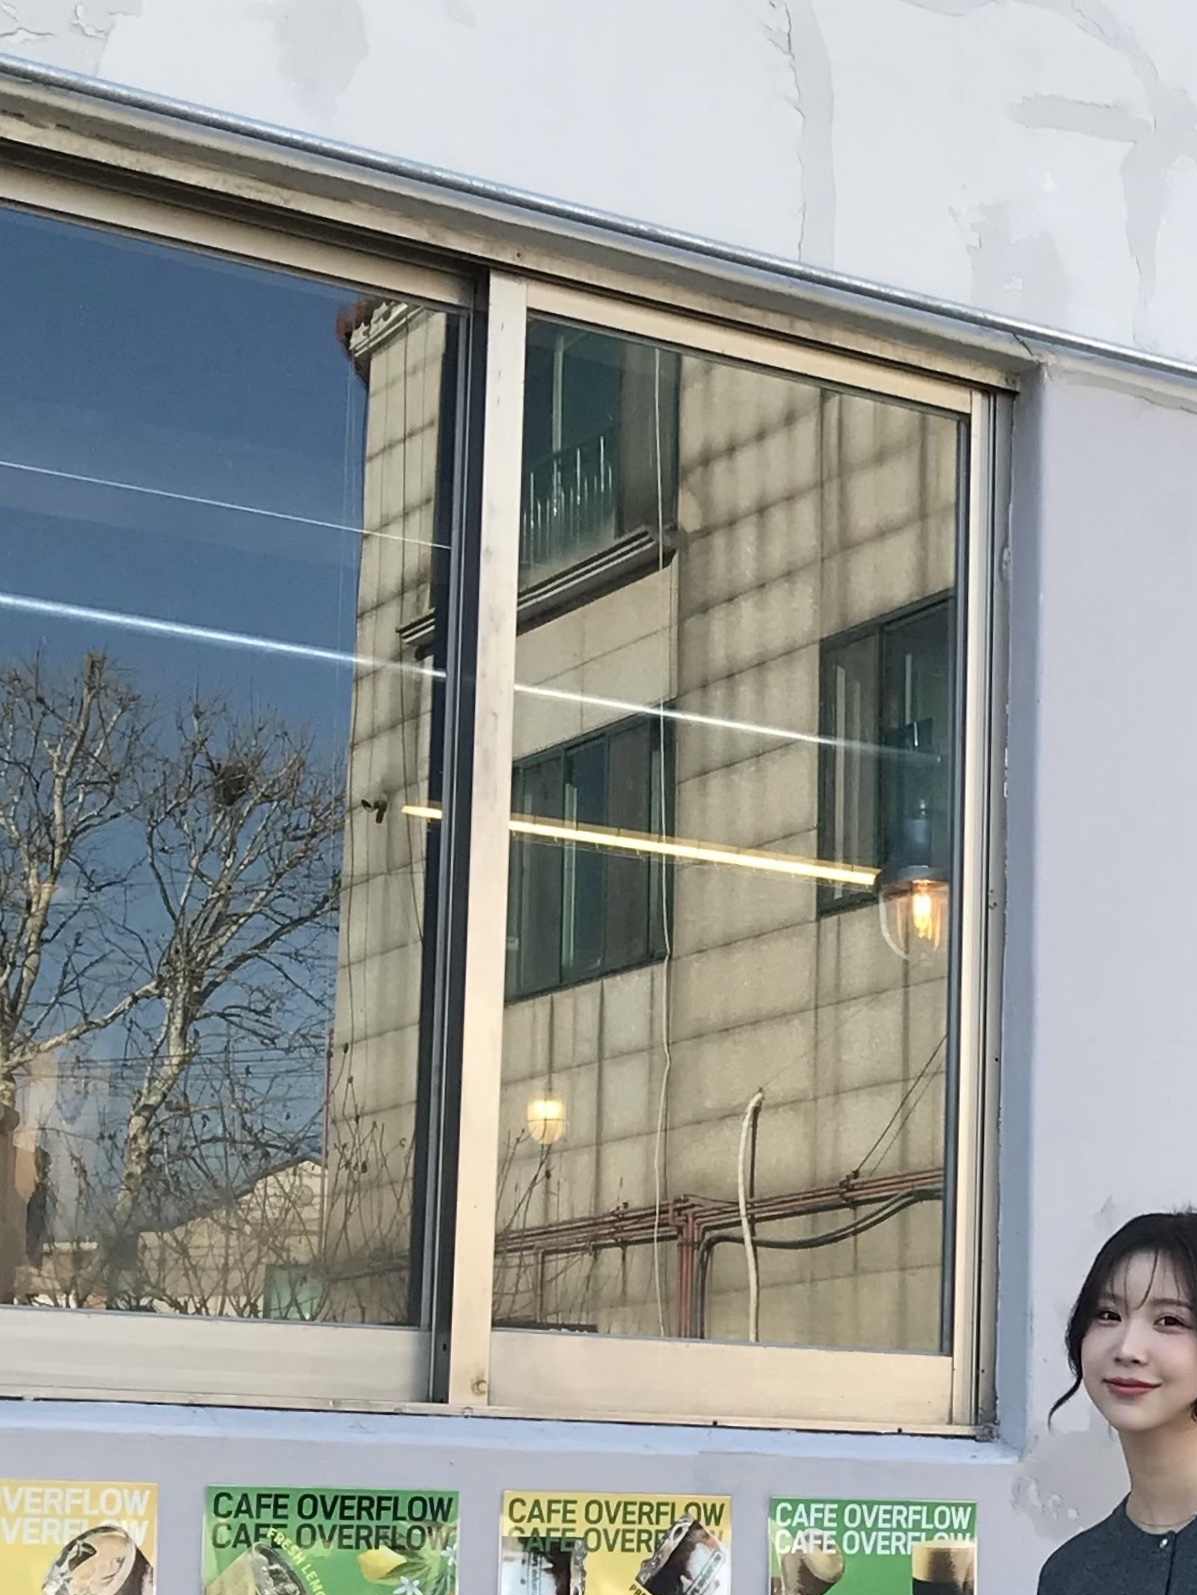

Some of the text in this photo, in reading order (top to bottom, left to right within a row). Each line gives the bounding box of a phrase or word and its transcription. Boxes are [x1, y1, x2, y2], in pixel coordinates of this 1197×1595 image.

[0, 1486, 151, 1517] VERFLOW
[213, 1491, 454, 1523] CAFE OVERFLOW
[508, 1498, 578, 1524] CAFE
[775, 1502, 972, 1530] CAFE OVERFLOW
[211, 1522, 452, 1551] CAFE OVERFLOW
[267, 1527, 307, 1565] FRESH
[774, 1529, 838, 1555] CAFE
